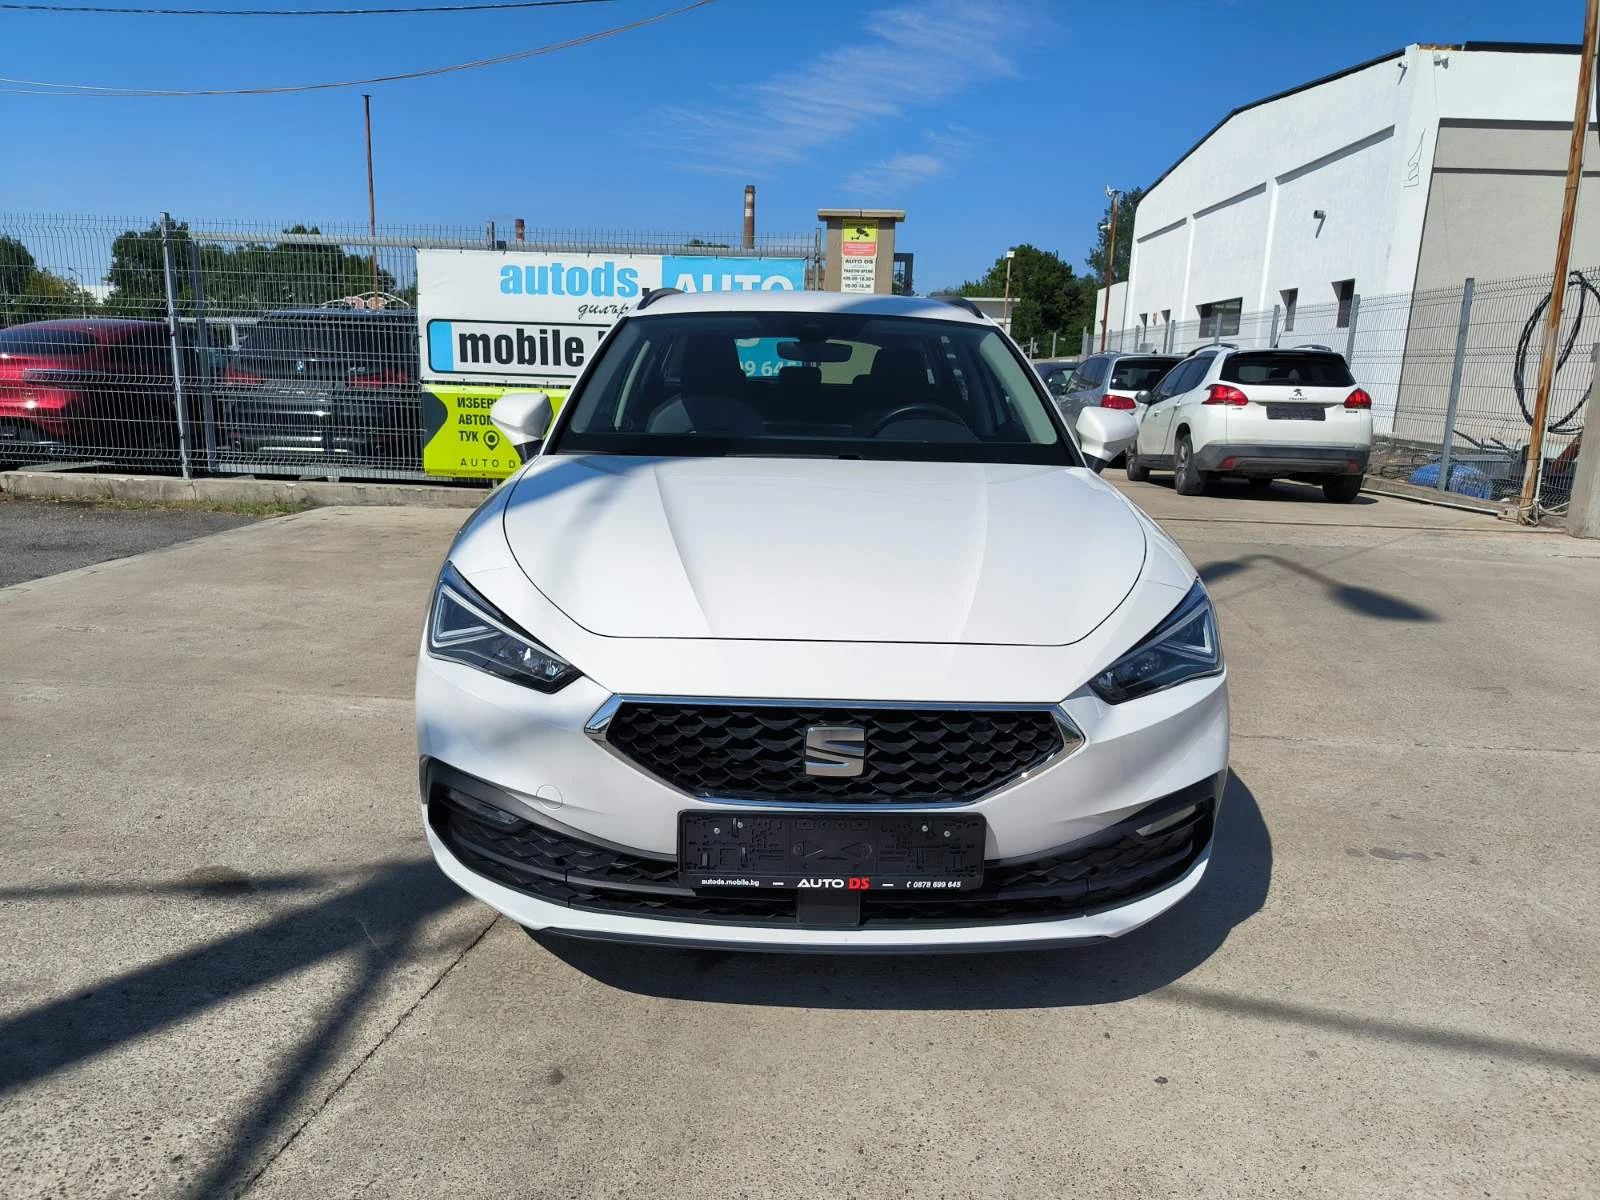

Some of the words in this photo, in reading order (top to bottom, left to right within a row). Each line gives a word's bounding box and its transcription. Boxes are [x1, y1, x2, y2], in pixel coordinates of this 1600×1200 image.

[458, 327, 606, 367] mobile
[457, 397, 497, 409] ИЗБЕР
[458, 430, 478, 442] ТУК
[460, 457, 499, 468] AUTO
[797, 878, 845, 888] AUTO
